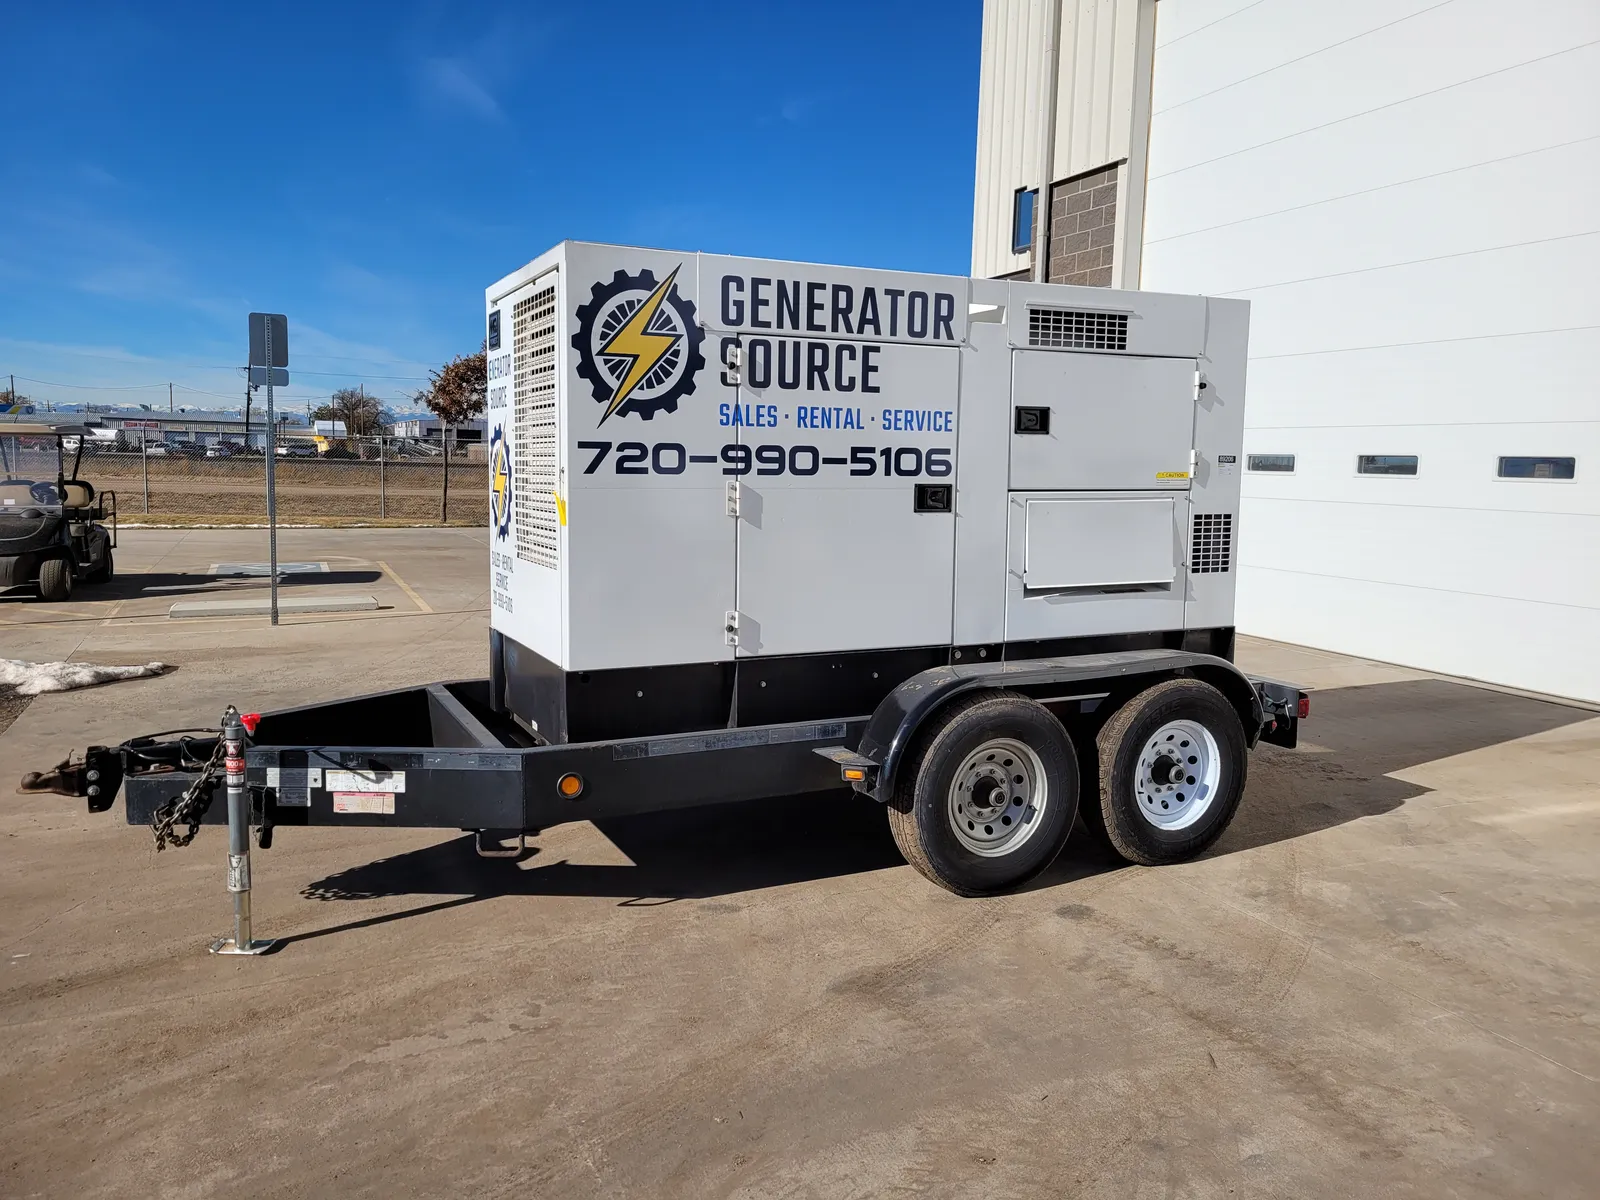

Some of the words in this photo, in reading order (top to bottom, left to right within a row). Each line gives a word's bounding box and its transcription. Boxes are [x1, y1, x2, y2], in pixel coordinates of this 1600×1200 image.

[720, 275, 955, 341] GENERATOR
[720, 336, 881, 393] SOURCE
[719, 403, 778, 427] SALES
[797, 406, 865, 430] RENTAL
[882, 409, 953, 432] SERVICE
[577, 441, 952, 476] 720-990-5106
